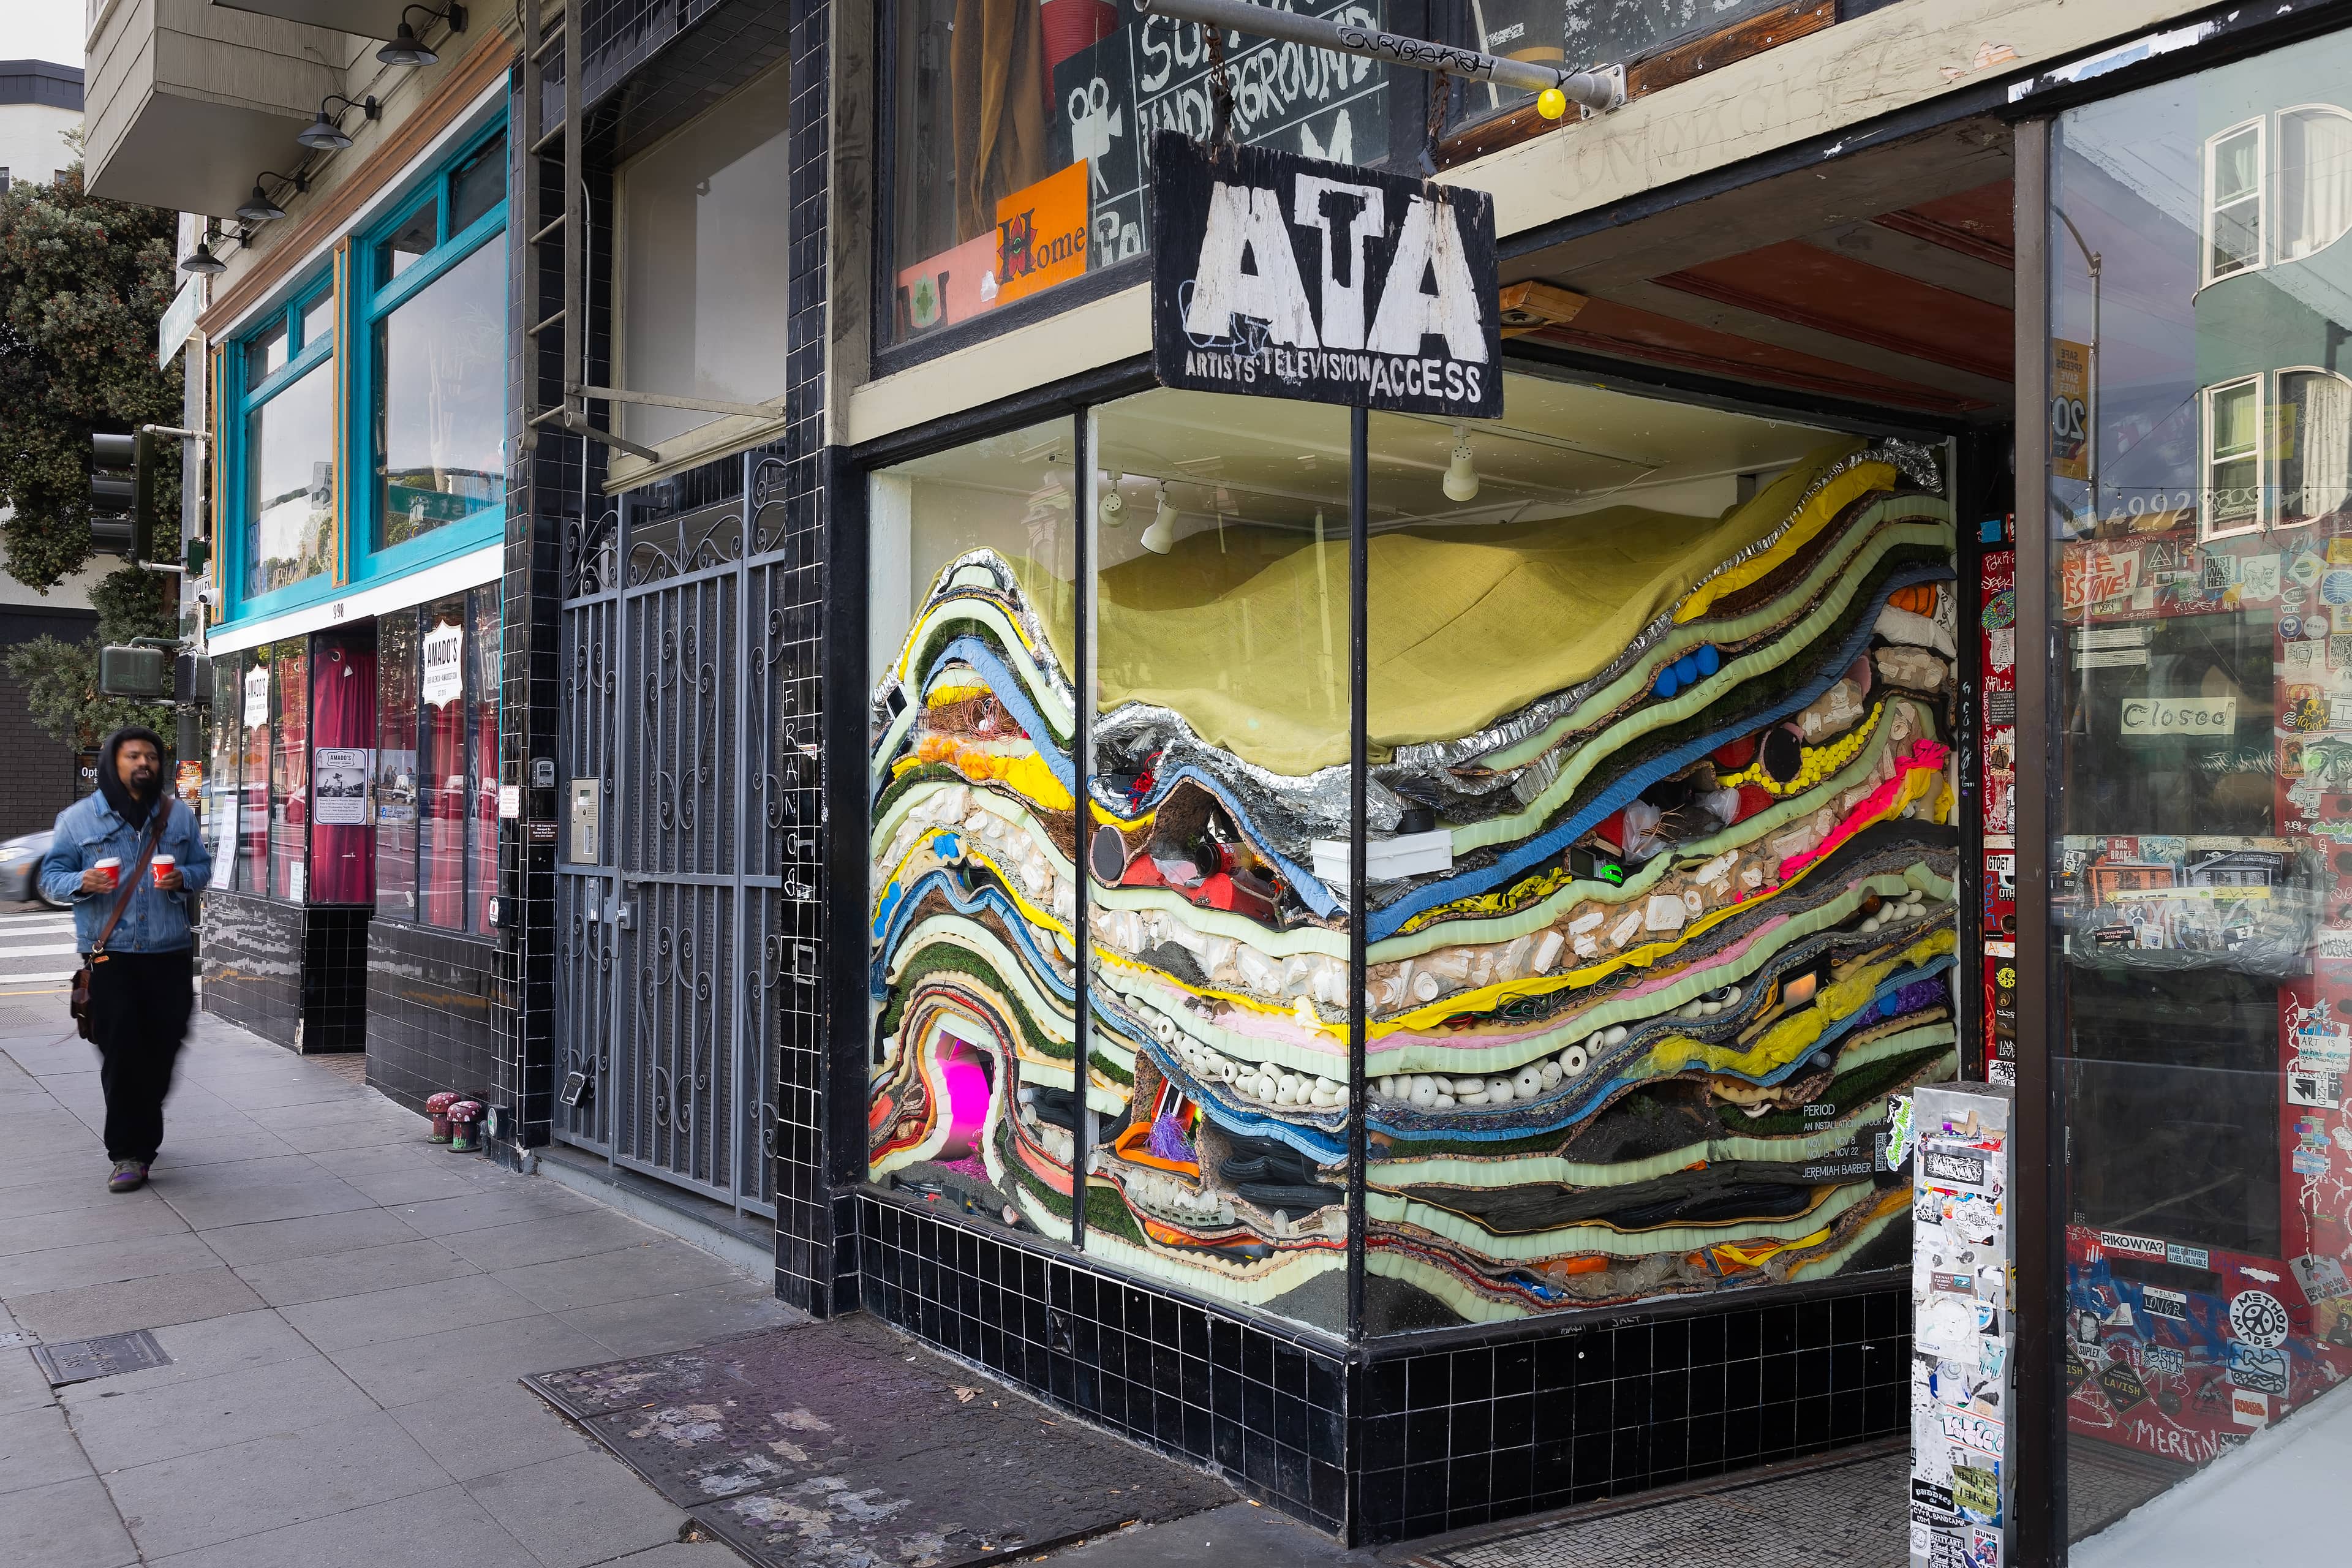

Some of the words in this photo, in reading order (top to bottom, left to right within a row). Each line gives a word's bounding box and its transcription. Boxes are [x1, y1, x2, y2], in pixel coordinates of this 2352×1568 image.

[998, 208, 1085, 285] Home
[1186, 173, 1489, 364] ATA
[1261, 347, 1371, 382] TELEVISION
[1369, 356, 1482, 404] ACCESS
[2128, 491, 2191, 530] 992
[2063, 556, 2116, 578] REE
[2206, 556, 2231, 569] DUST
[2206, 566, 2231, 578] WAS
[2207, 576, 2231, 588] HERE
[333, 603, 344, 619] 998
[428, 637, 458, 668] AMADO'S
[247, 677, 266, 699] AMADO'S
[2124, 701, 2235, 728] Closed
[2111, 850, 2132, 860] BRAKE
[1988, 856, 2009, 870] GTOET
[2301, 1038, 2320, 1047] ART
[2316, 1057, 2335, 1066] away
[1803, 1104, 1836, 1117] PERIOD
[1803, 1123, 1814, 1131] AN
[1814, 1120, 1858, 1131] INSTALLATION
[1865, 1118, 1881, 1127] FOUR
[1807, 1138, 1822, 1148] NOV
[1834, 1136, 1849, 1146] NOV
[1851, 1136, 1855, 1145] 8
[1807, 1150, 1822, 1159] NOV
[1823, 1149, 1830, 1158] 15
[1834, 1147, 1849, 1157] NOV
[1850, 1147, 1859, 1156] 22
[1802, 1165, 1839, 1181] JEREMIAH
[1841, 1163, 1871, 1175] BARBER
[2101, 1233, 2163, 1253] RIKOWYA?
[2169, 1245, 2180, 1254] MAKE
[2180, 1247, 2207, 1259] GNTRIFIERS'
[2182, 1256, 2207, 1267] UNLIVABLE
[2154, 1289, 2177, 1298] HELLO
[2305, 1284, 2322, 1295] STUPID
[2237, 1292, 2286, 1334] METHOD
[2078, 1345, 2101, 1359] SUPLEX
[2067, 1365, 2082, 1376] ISH
[2113, 1368, 2133, 1378] GUARANTEED
[2104, 1376, 2141, 1396] LAVISH
[1946, 1408, 1976, 1422] PRIORITY
[1915, 1488, 1952, 1506] PUDDLES
[1917, 1515, 1931, 1525] COM
[1975, 1529, 1996, 1542] BUNS
